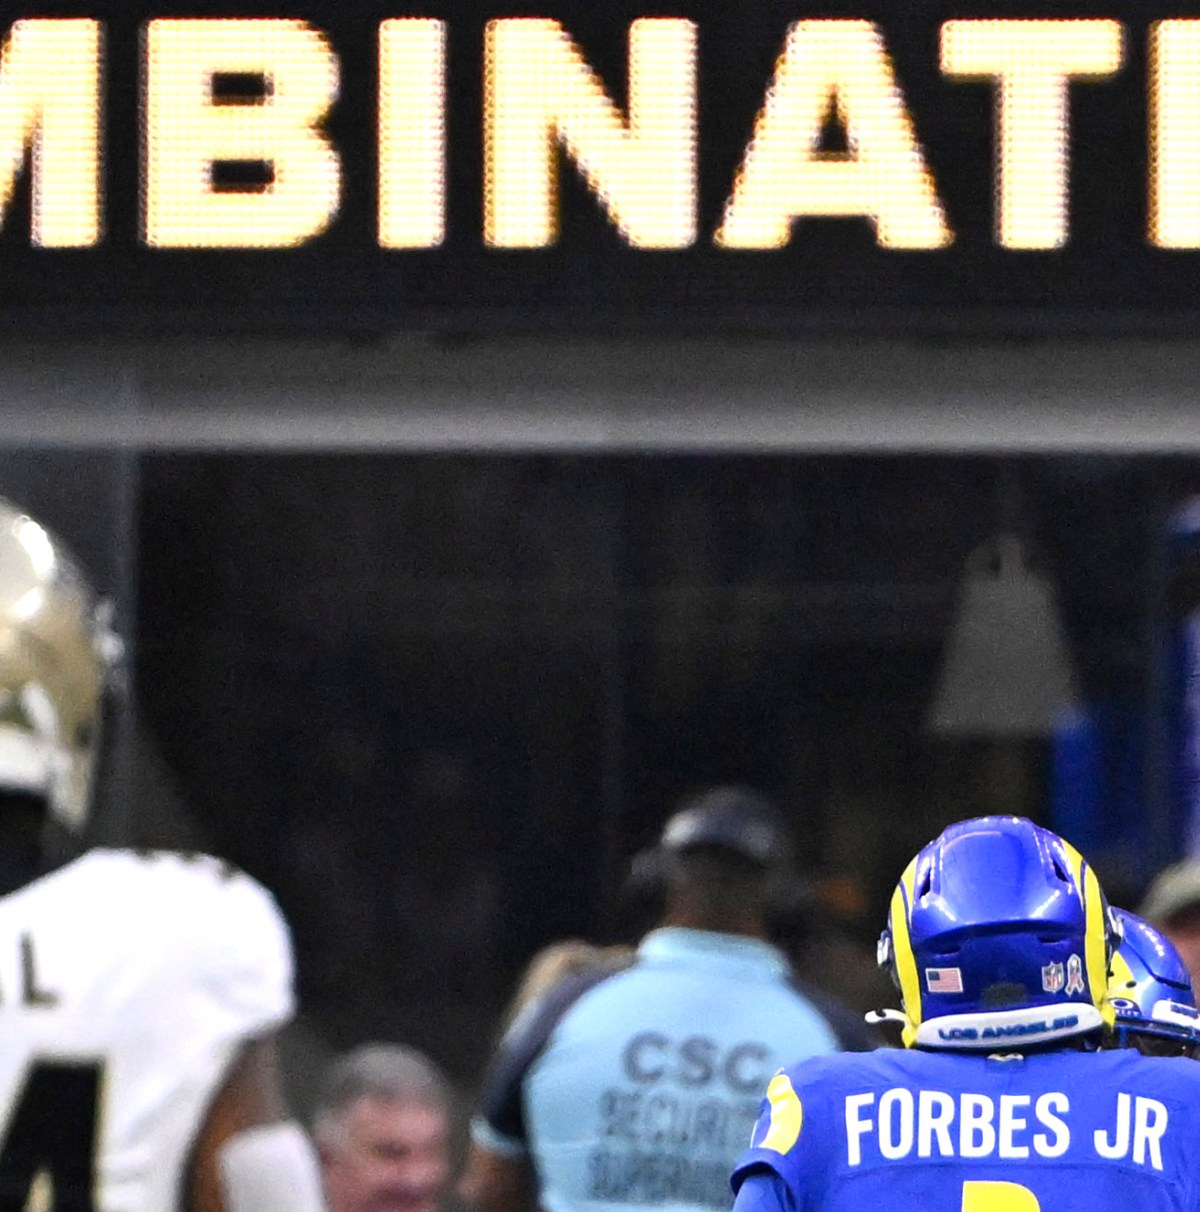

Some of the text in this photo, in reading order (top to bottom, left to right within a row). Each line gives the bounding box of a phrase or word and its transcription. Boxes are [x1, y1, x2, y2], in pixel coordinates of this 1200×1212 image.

[937, 1014, 1079, 1041] LOS ANGELES
[622, 1029, 773, 1095] CSC
[845, 1087, 1169, 1171] FORBES JR
